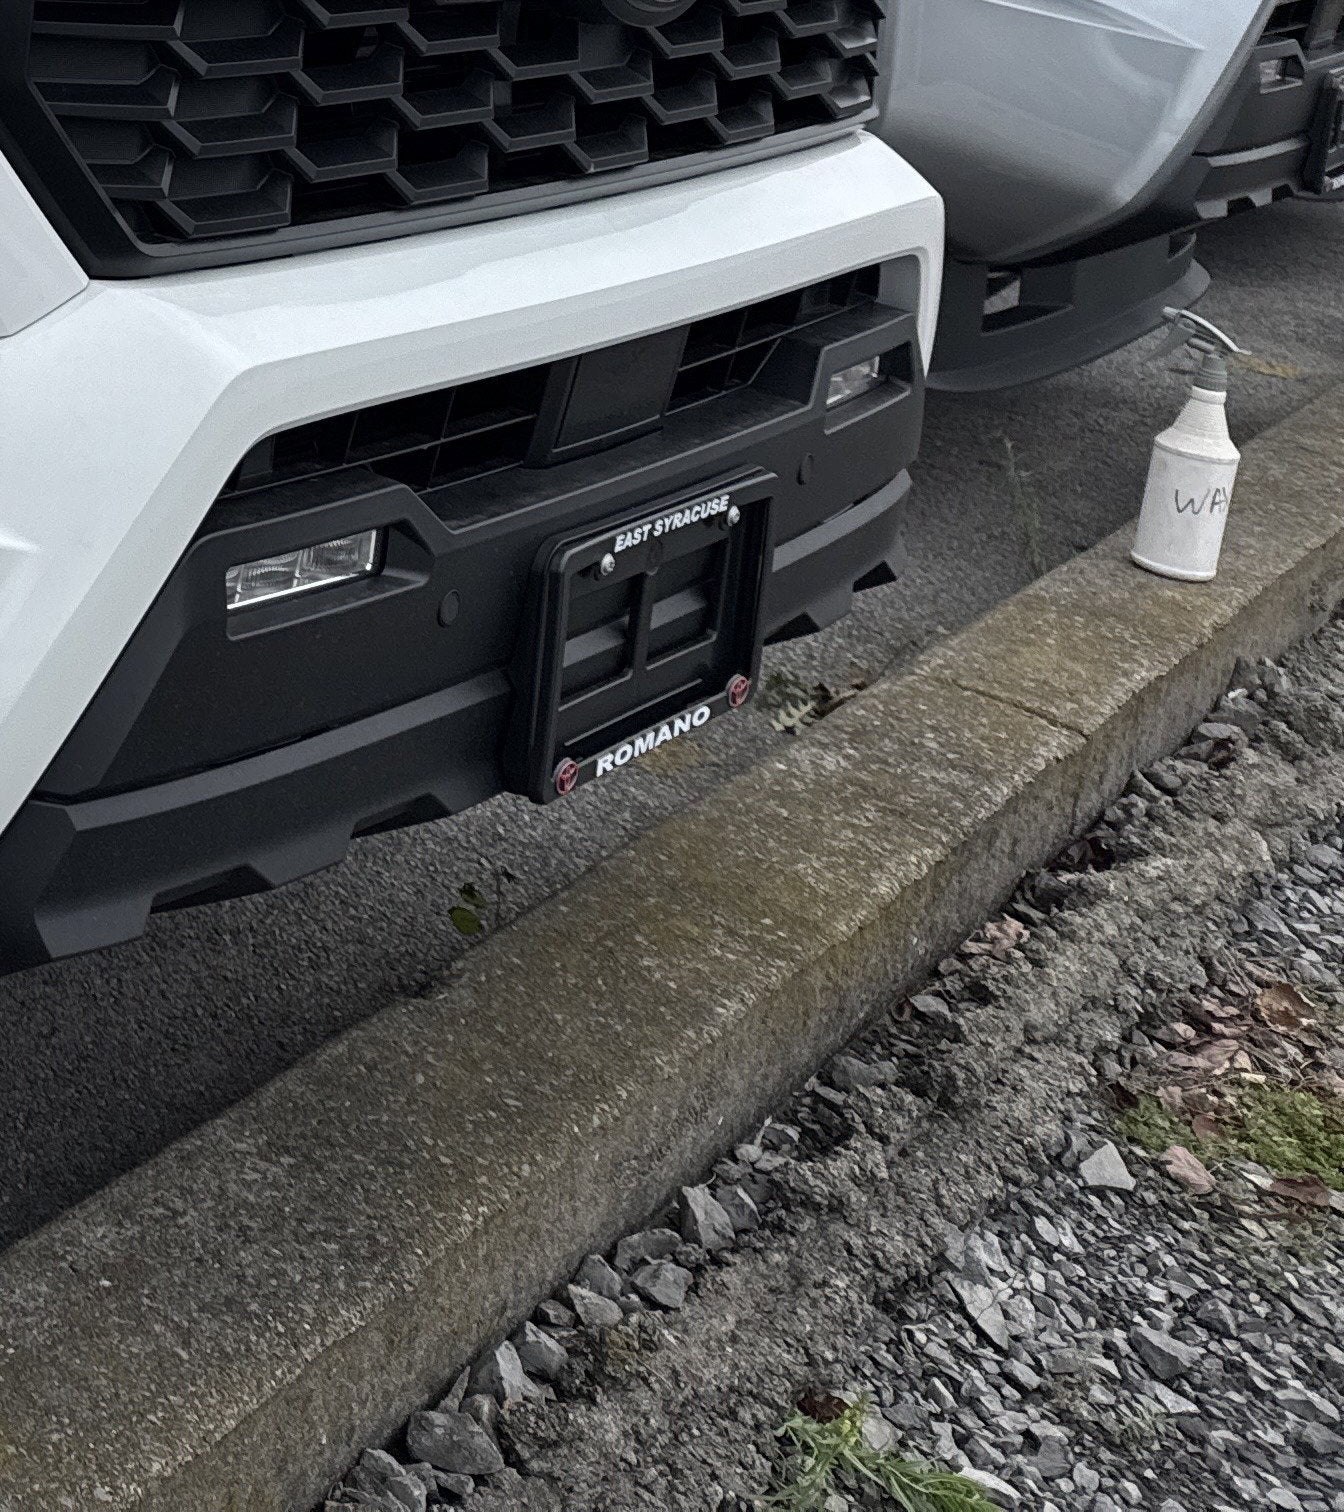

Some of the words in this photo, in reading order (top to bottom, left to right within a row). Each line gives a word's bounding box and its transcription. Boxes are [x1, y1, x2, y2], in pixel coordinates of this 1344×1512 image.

[614, 523, 652, 553] EAST
[653, 494, 730, 537] SYRACUSE
[596, 705, 711, 778] ROMANO
